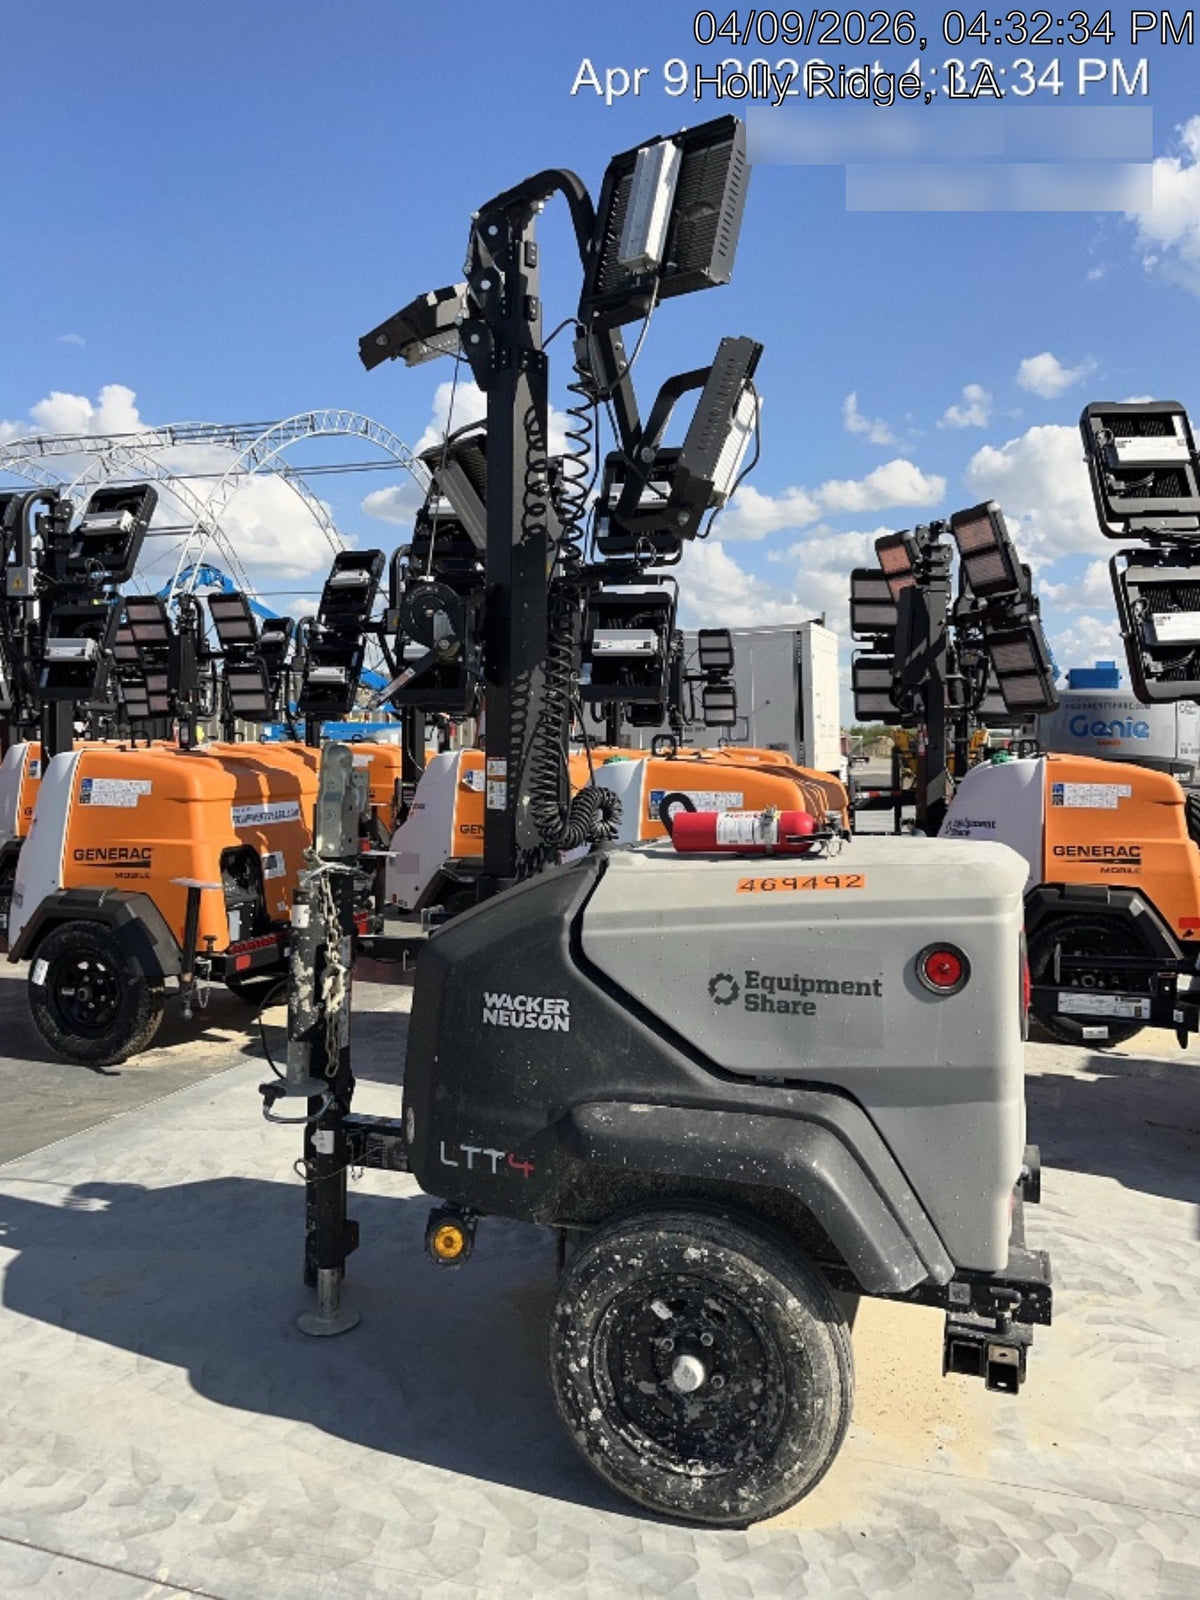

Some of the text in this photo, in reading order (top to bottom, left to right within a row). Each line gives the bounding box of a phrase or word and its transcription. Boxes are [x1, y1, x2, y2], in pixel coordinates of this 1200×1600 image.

[1068, 713, 1149, 738] Genie
[73, 847, 152, 861] GENERAC
[1053, 845, 1141, 857] GENERAC
[738, 874, 861, 892] 469492
[744, 969, 883, 998] Equipment
[483, 991, 571, 1016] WACKER
[744, 993, 817, 1016] Share
[482, 1007, 570, 1032] NEUSON
[440, 1140, 535, 1179] LTT4
